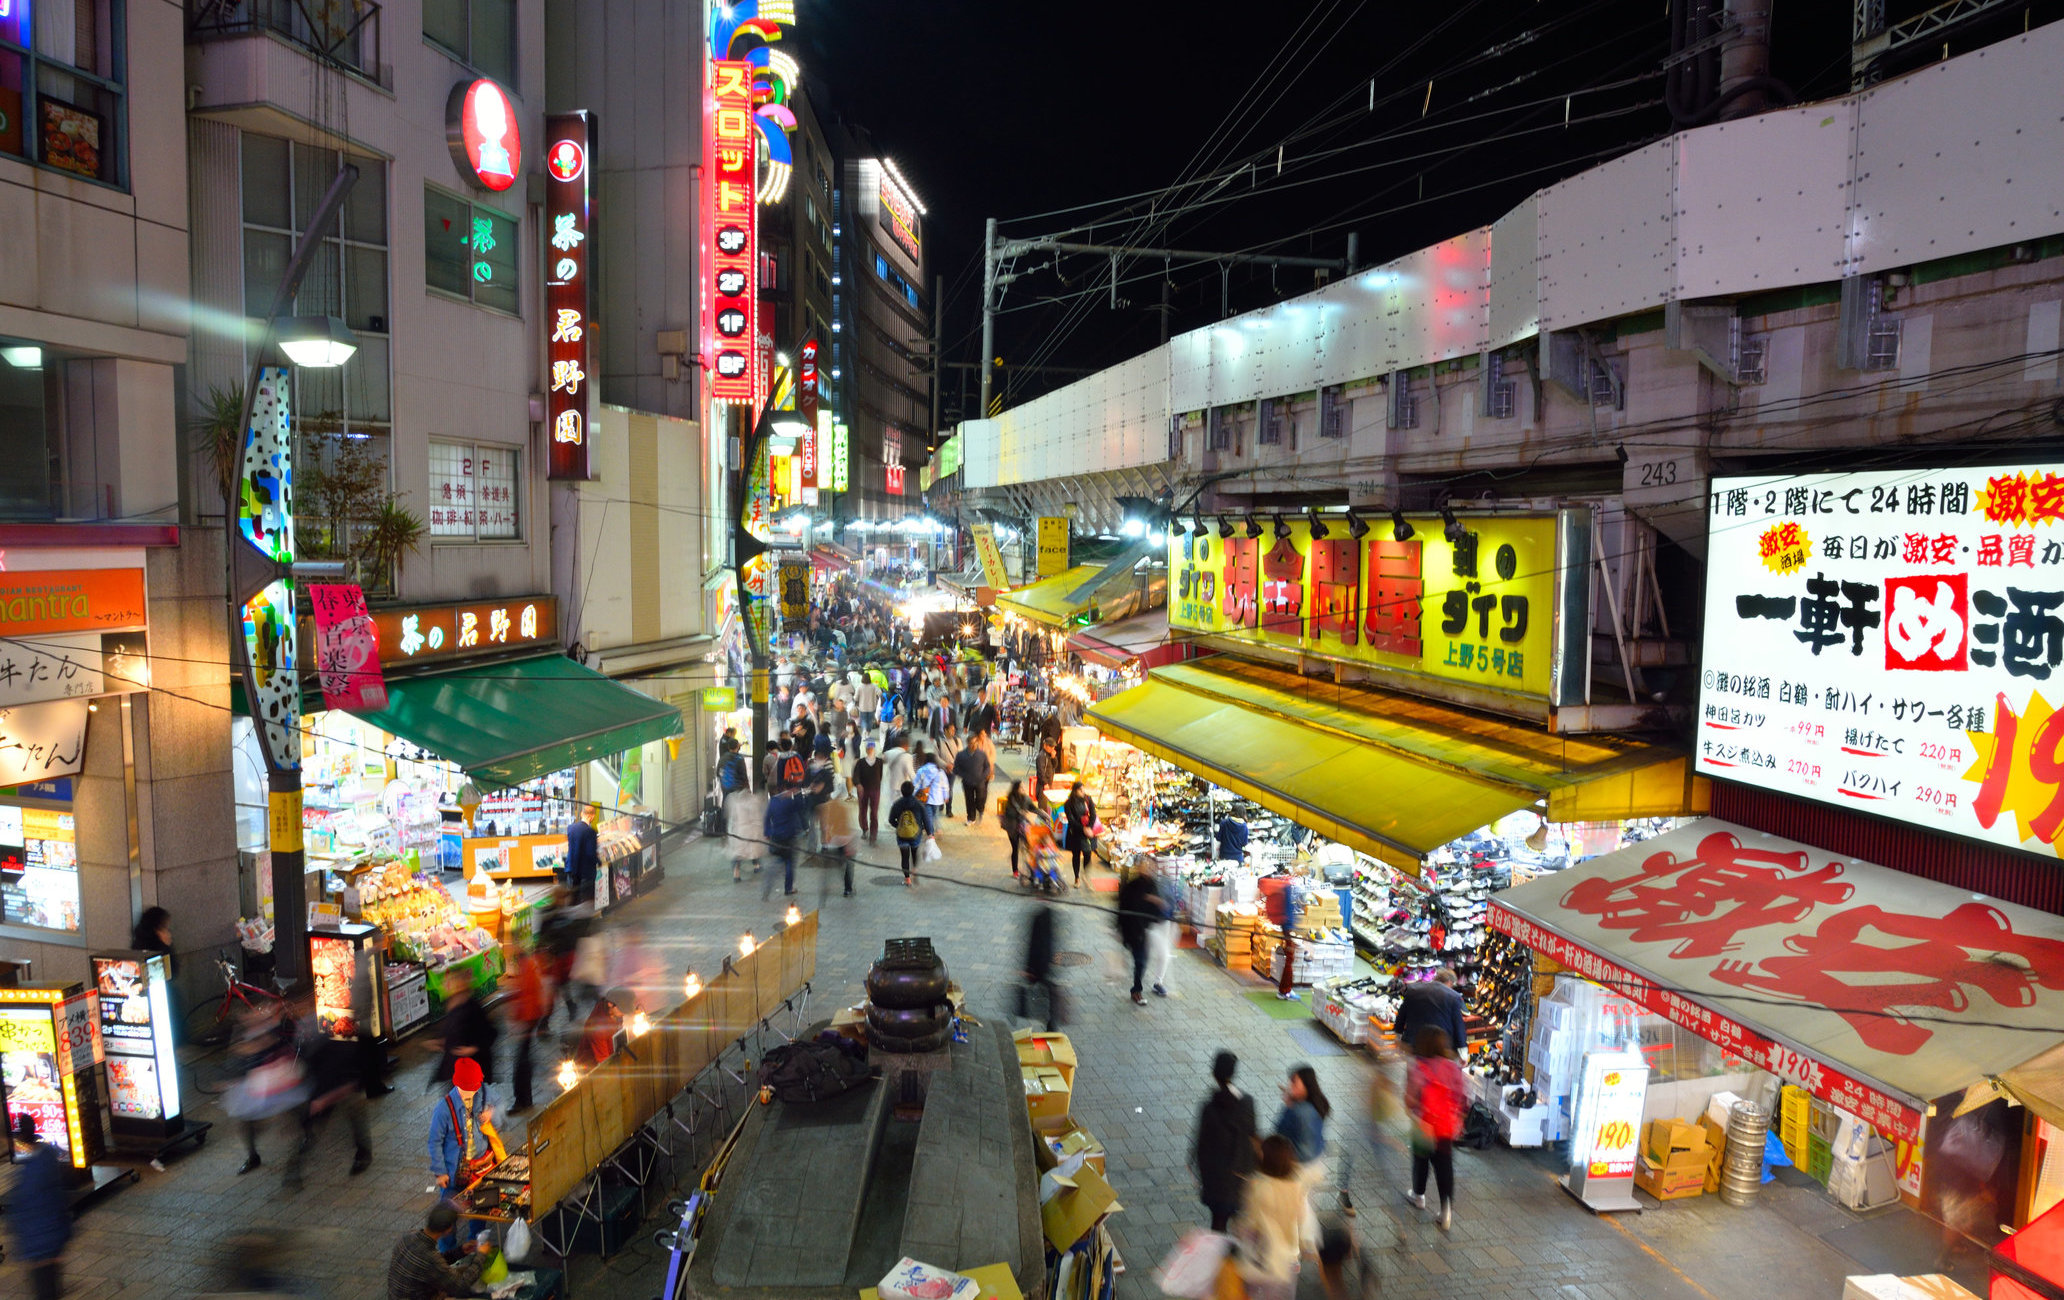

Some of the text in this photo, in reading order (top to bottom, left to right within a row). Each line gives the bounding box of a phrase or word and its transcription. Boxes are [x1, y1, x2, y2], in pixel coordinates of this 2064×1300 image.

[716, 67, 748, 212] スロット
[719, 232, 745, 250] 3F
[719, 274, 745, 292] 2F
[719, 314, 744, 332] 1F
[462, 458, 490, 476] 2F
[1641, 462, 1677, 485] 243
[1711, 481, 1970, 517] 1階・2階にて24時間
[1985, 472, 2064, 523] 激安
[1040, 545, 1067, 554] face
[1758, 522, 1800, 558] 激安
[1780, 549, 1806, 570] 酒場
[26, 584, 83, 595] RESTAURANT
[1222, 537, 1424, 659] 現金問屋
[1442, 581, 1529, 643] ダイワ
[0, 654, 79, 689] 牛たん
[1443, 641, 1524, 679] 上野5号店
[63, 680, 95, 697] 専門店
[1797, 721, 1825, 738] 99円
[1844, 726, 1906, 755] 揚げたて
[1703, 739, 1778, 770] 牛スジ煮込み
[1919, 742, 1962, 763] 220円
[1787, 759, 1823, 779] 270円
[1842, 770, 1902, 797] バクハイ
[1915, 785, 1958, 808] 290円
[60, 1021, 96, 1053] 839
[1595, 1121, 1631, 1151] 190
